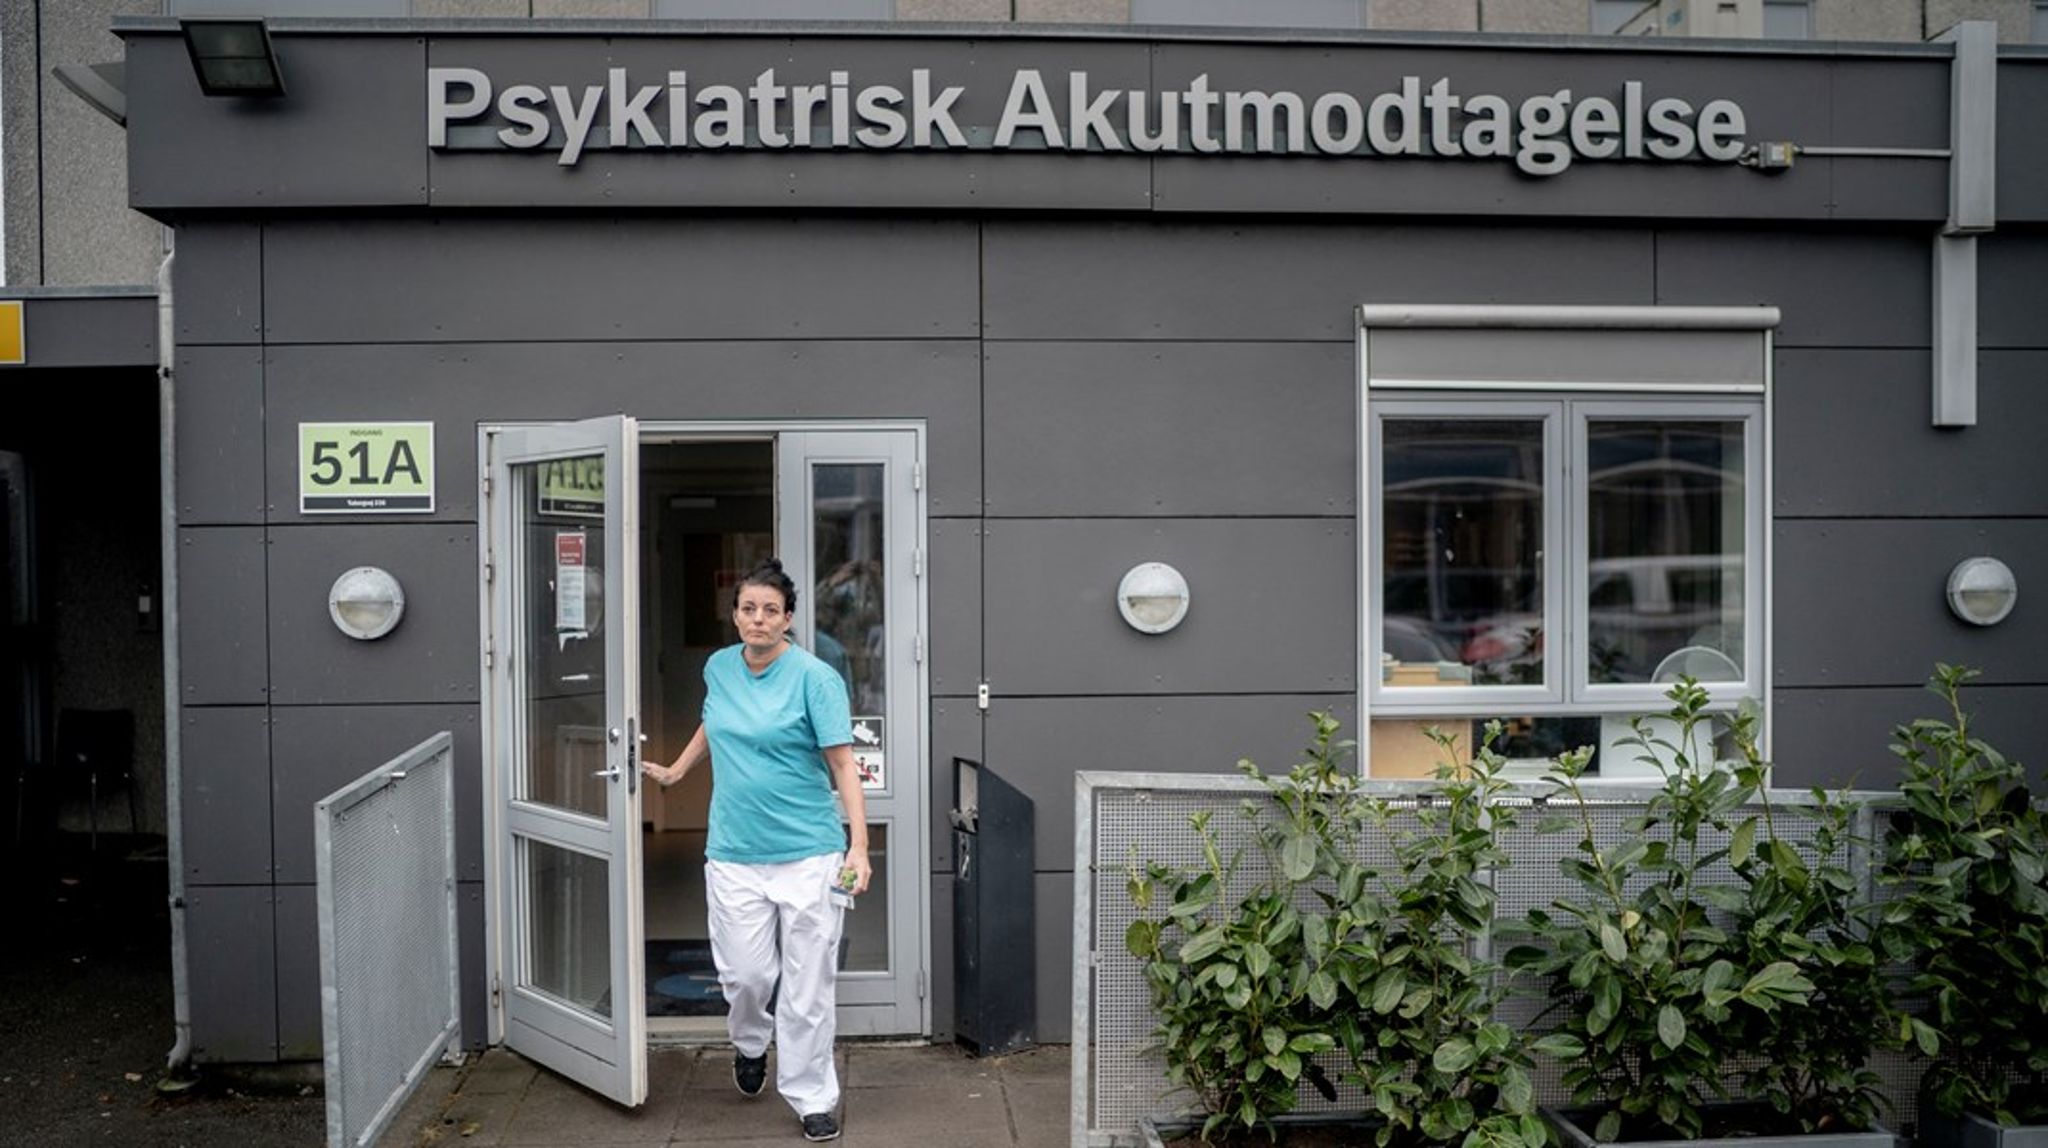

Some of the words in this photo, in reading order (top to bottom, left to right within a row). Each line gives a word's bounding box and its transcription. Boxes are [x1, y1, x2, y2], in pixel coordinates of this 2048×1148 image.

[427, 67, 969, 167] Psykiatrisk
[993, 68, 1747, 176] Akutmodtagelse
[310, 440, 422, 486] 51A
